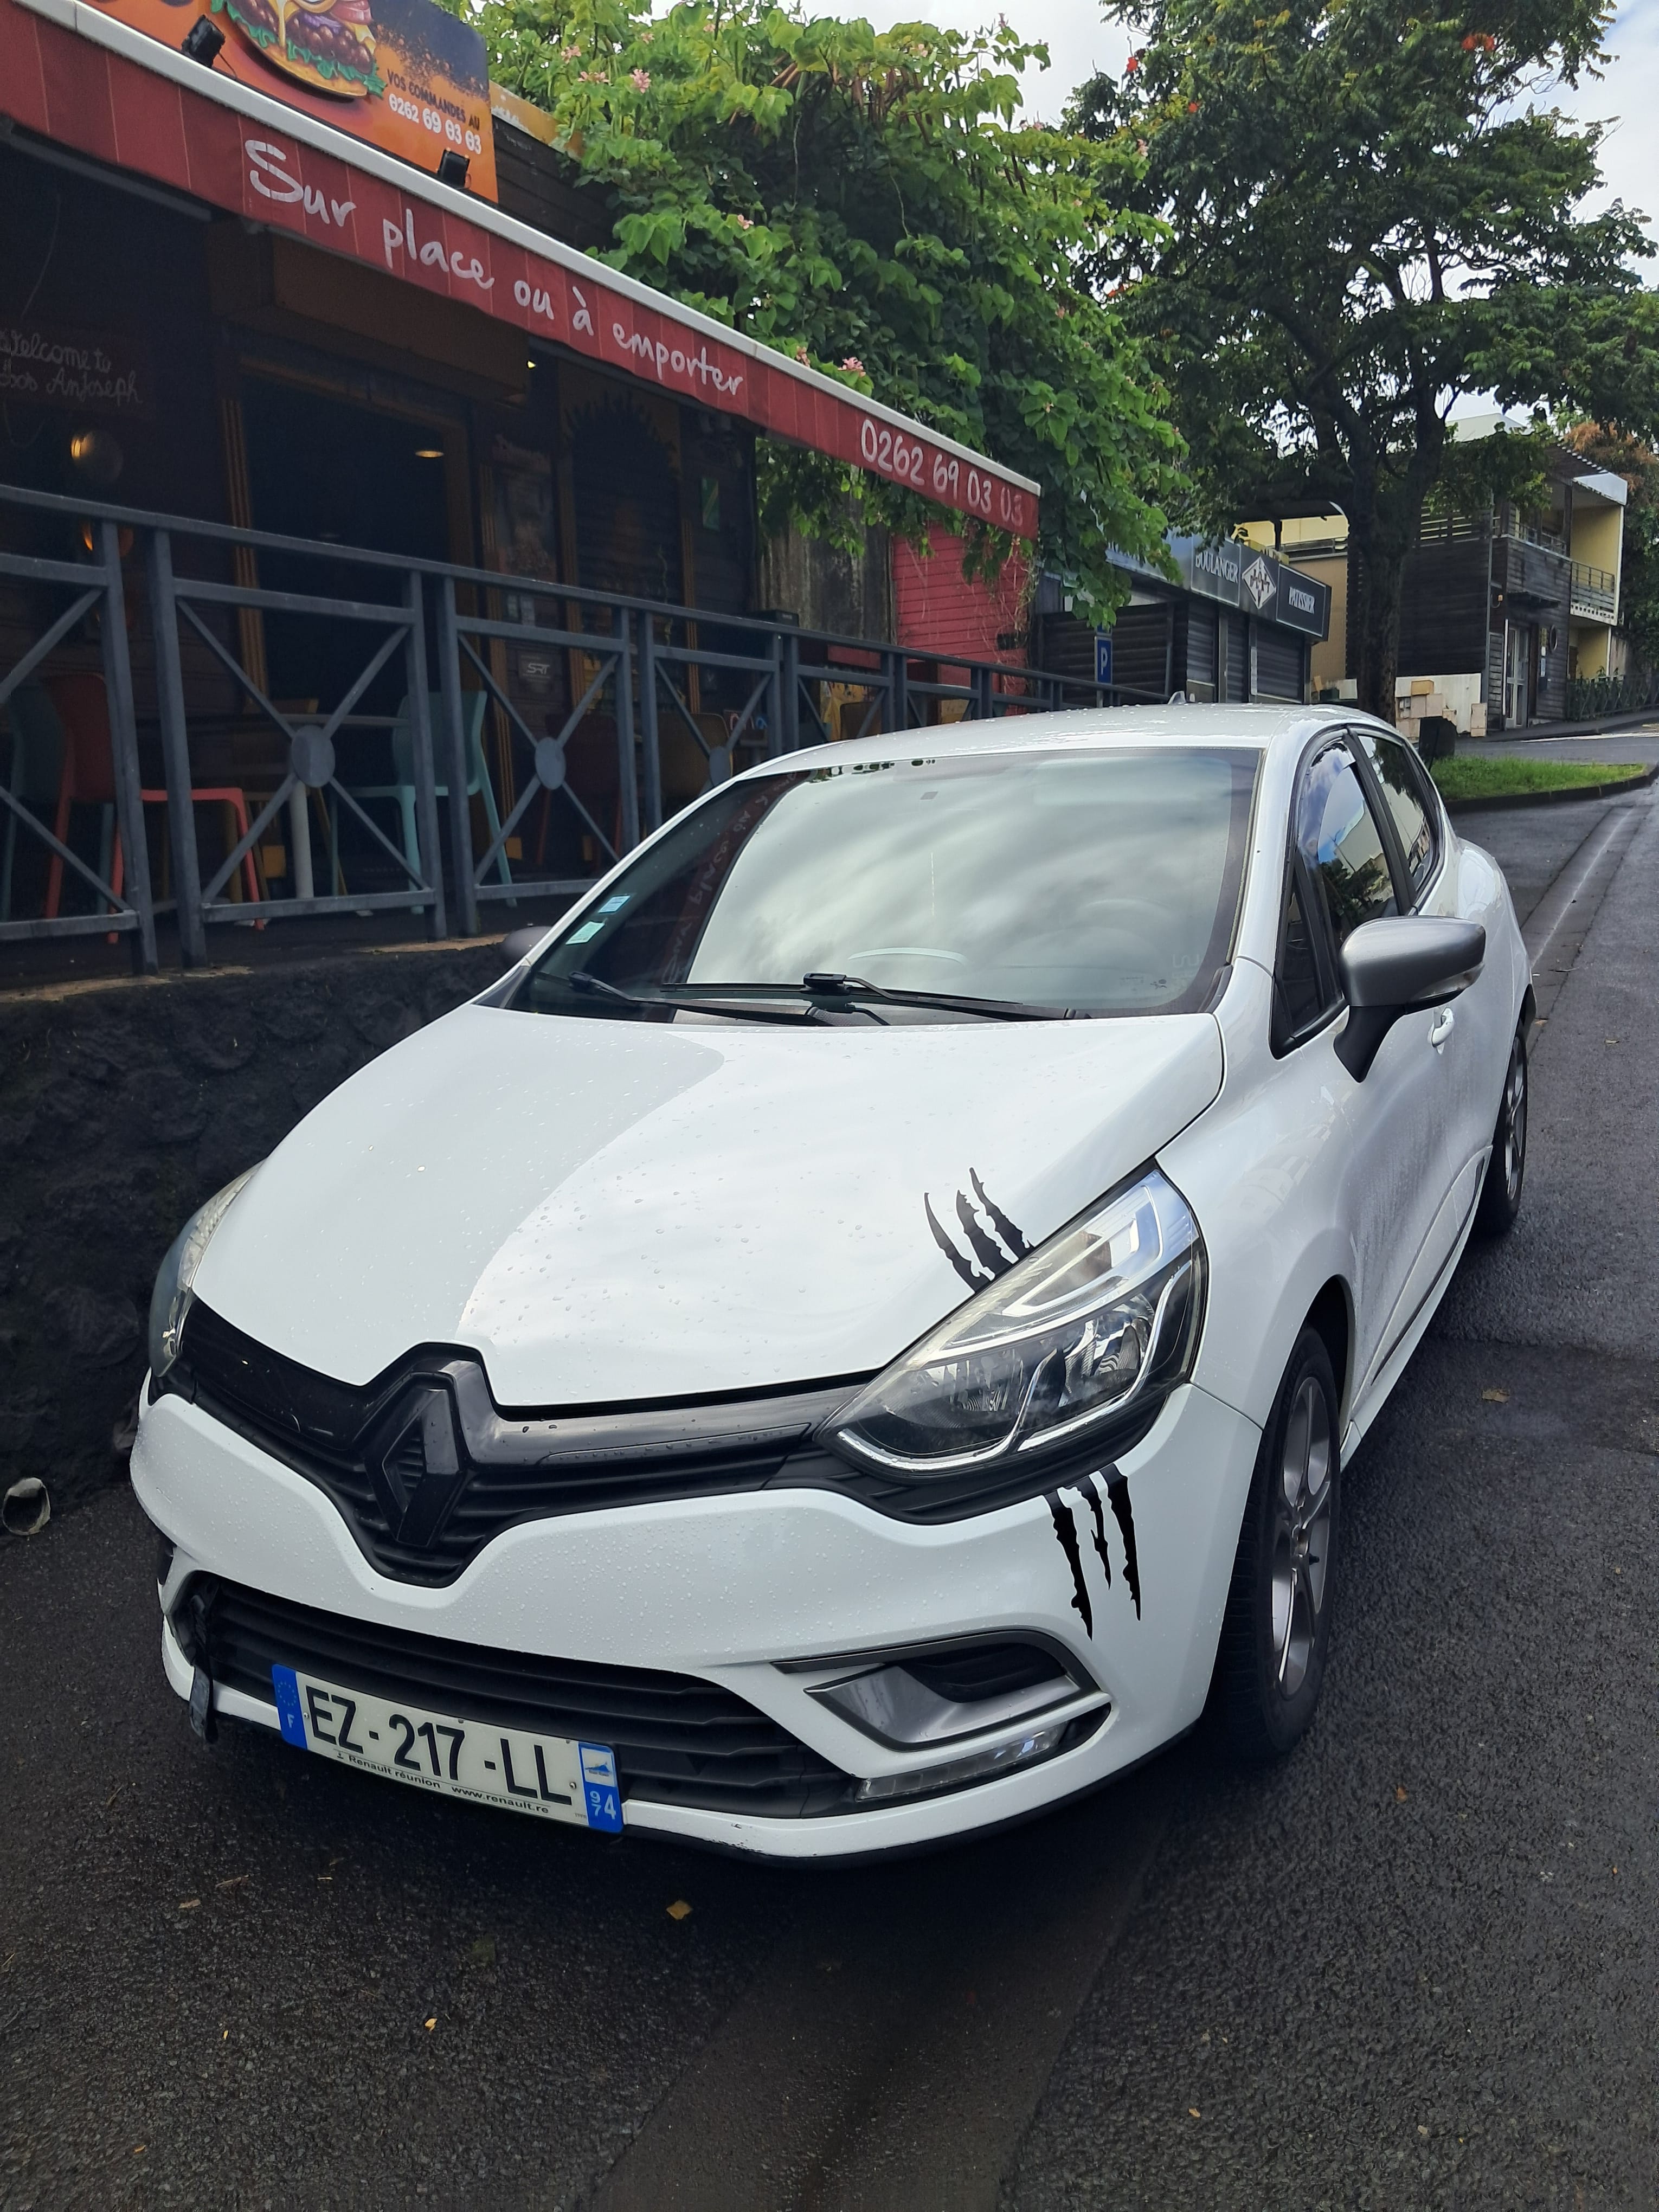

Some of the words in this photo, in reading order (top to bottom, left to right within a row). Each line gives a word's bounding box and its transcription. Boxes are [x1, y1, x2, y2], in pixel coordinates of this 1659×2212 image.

[387, 68, 406, 92] VOS
[468, 114, 480, 131] AU
[389, 93, 419, 124] 0262
[422, 108, 442, 133] 69
[445, 120, 462, 144] 03
[465, 130, 481, 155] 03
[245, 139, 357, 227] Sur
[383, 208, 496, 290] place
[514, 280, 555, 320] ou
[573, 286, 594, 336] à
[613, 322, 743, 395] emporter
[93, 348, 112, 374] to
[861, 419, 925, 486] 0262
[933, 454, 960, 500] 69
[967, 470, 992, 514] 03
[1195, 550, 1238, 584] BOULANGER
[1101, 647, 1108, 676] P
[287, 1713, 295, 1728] F
[349, 1754, 393, 1776] Renault
[395, 1766, 441, 1789] réunion
[452, 1785, 549, 1814] www.renault.re
